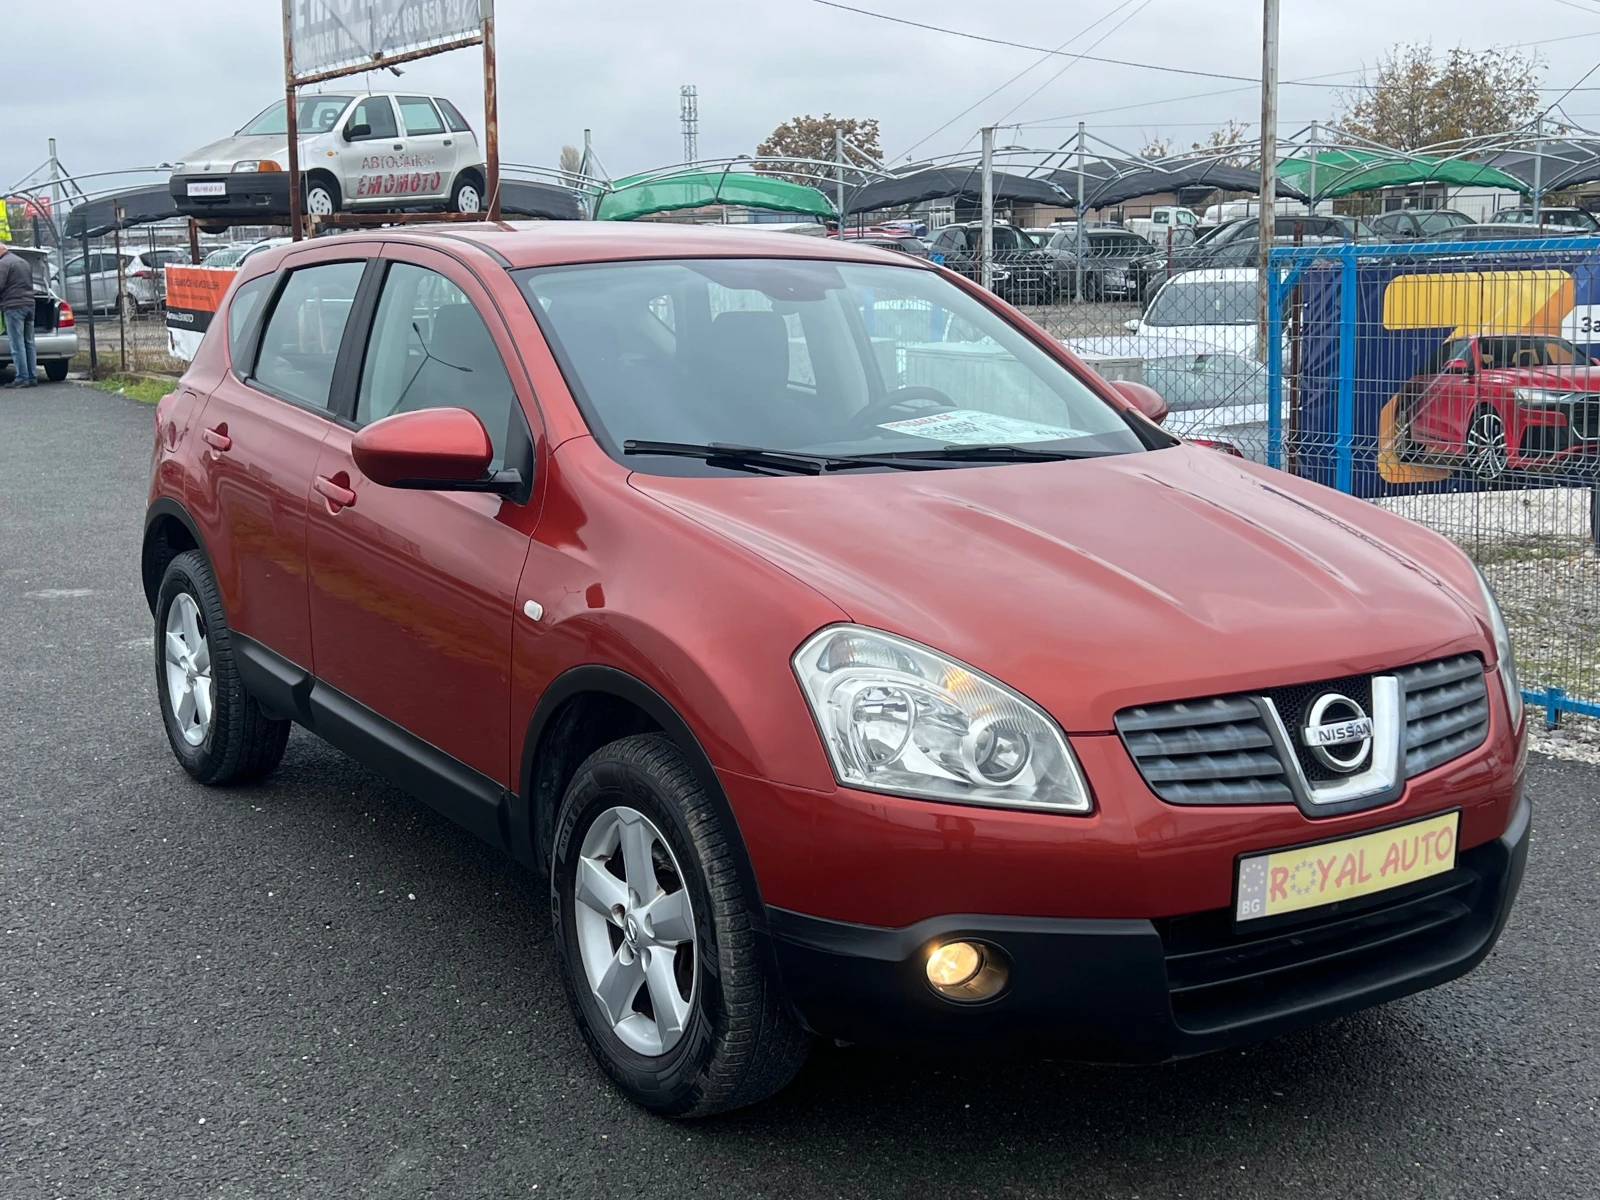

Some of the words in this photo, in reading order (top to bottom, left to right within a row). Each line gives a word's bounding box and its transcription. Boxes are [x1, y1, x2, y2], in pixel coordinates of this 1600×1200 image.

[375, 12, 400, 39] +359
[402, 5, 420, 34] 888
[422, 0, 443, 29] 658
[1318, 723, 1372, 742] NISSAN
[1269, 849, 1372, 902] ROYAL
[1380, 826, 1454, 877] AUTO
[1241, 899, 1260, 915] BG
